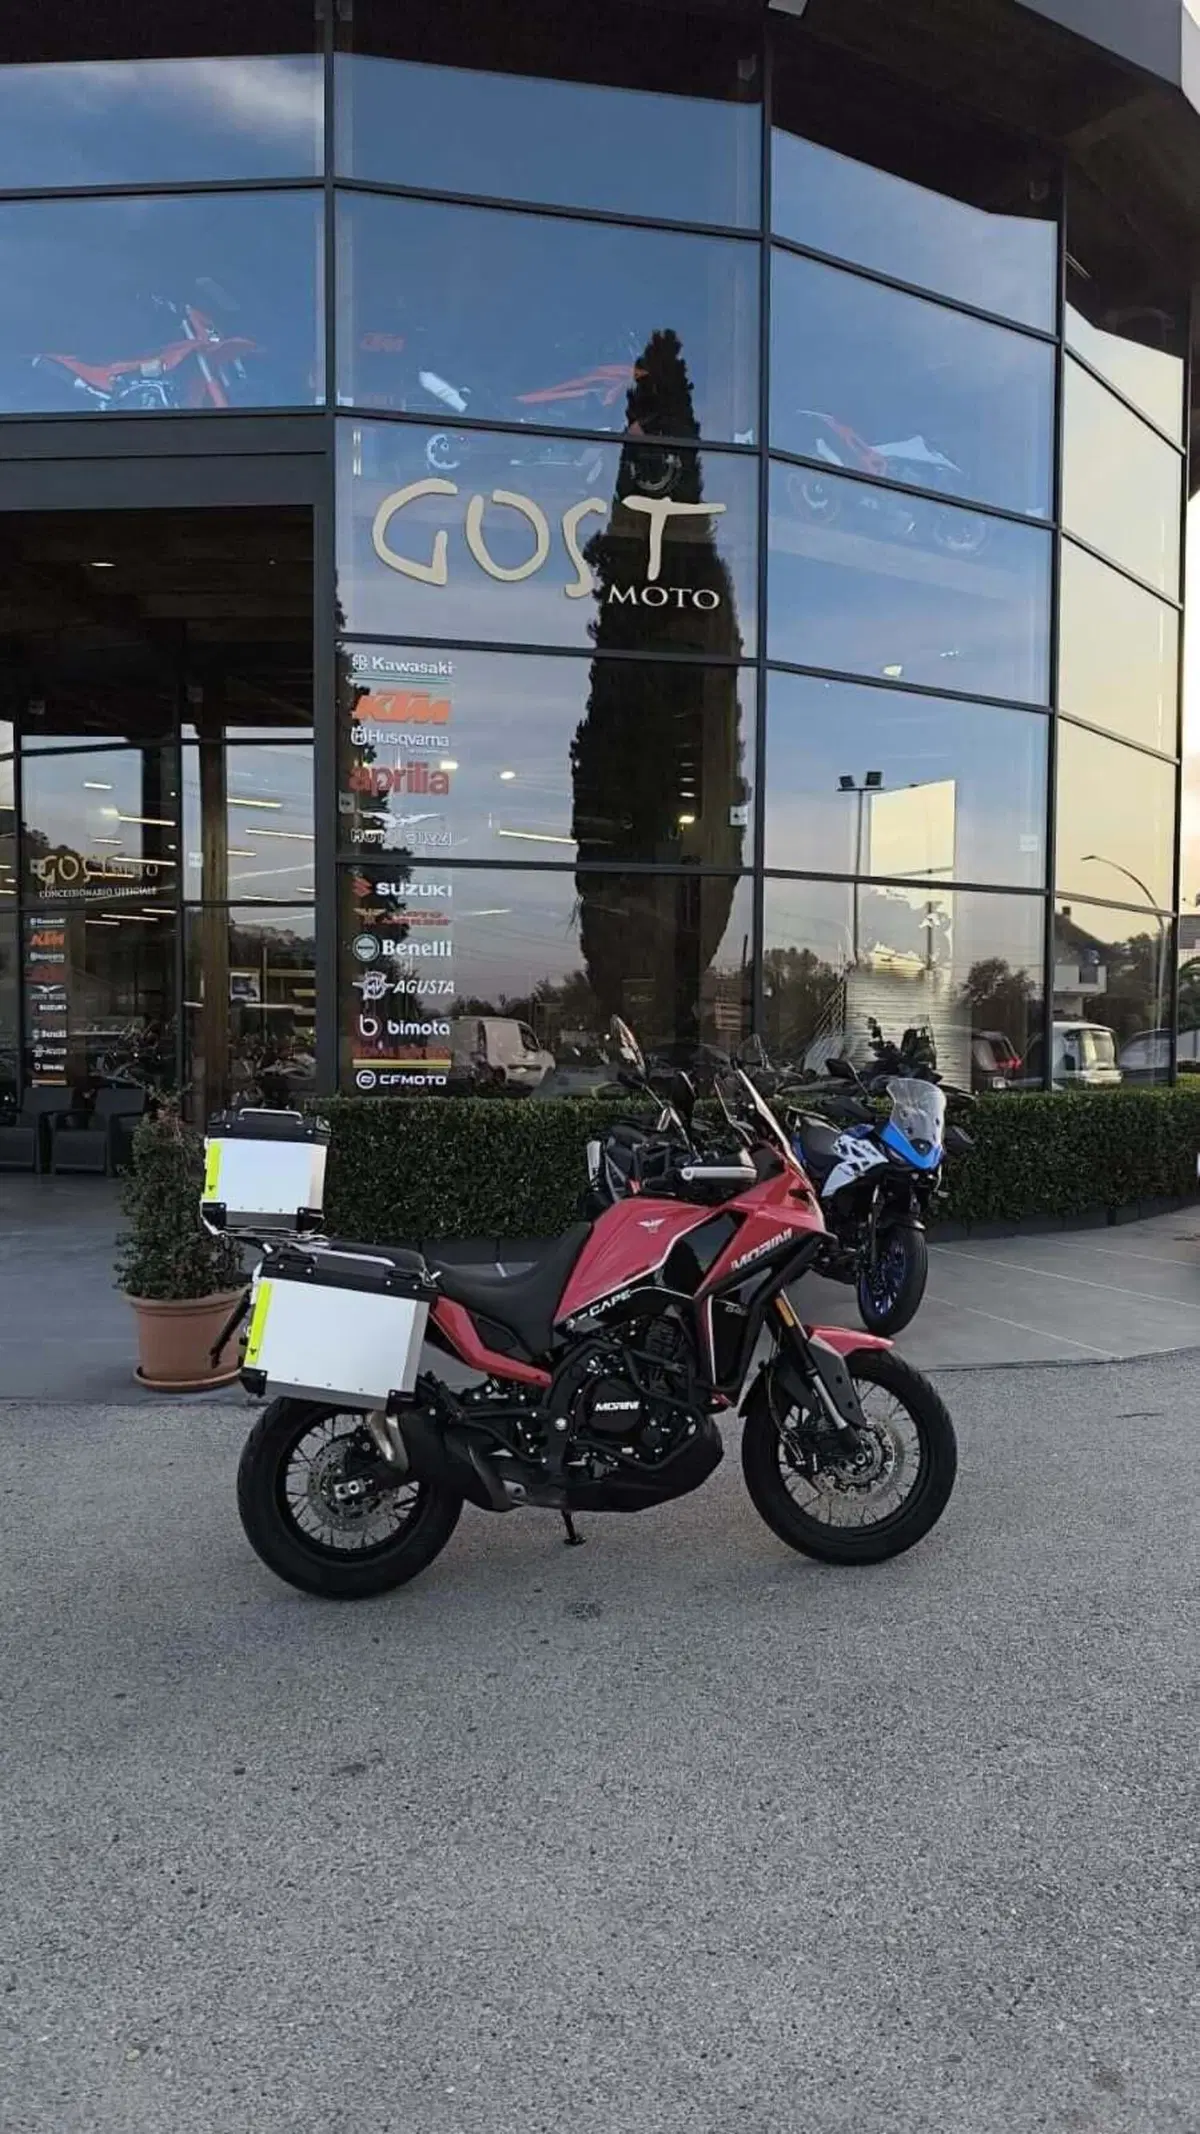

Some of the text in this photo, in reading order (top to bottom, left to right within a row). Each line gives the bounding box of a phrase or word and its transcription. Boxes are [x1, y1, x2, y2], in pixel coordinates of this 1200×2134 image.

[373, 478, 727, 598] GOST
[608, 586, 720, 609] MOTO
[372, 656, 453, 674] Kawasaki
[354, 690, 450, 724] KTM
[368, 729, 450, 748] Husqvarna
[349, 761, 450, 796] aprilia
[376, 882, 452, 897] SUZUKI
[382, 939, 452, 957] Benelli
[393, 979, 456, 995] AGUSTA
[387, 1019, 450, 1036] bimota
[379, 1074, 448, 1086] CFMOTO
[730, 1227, 792, 1271] MORINI
[594, 1400, 640, 1412] MORINI
